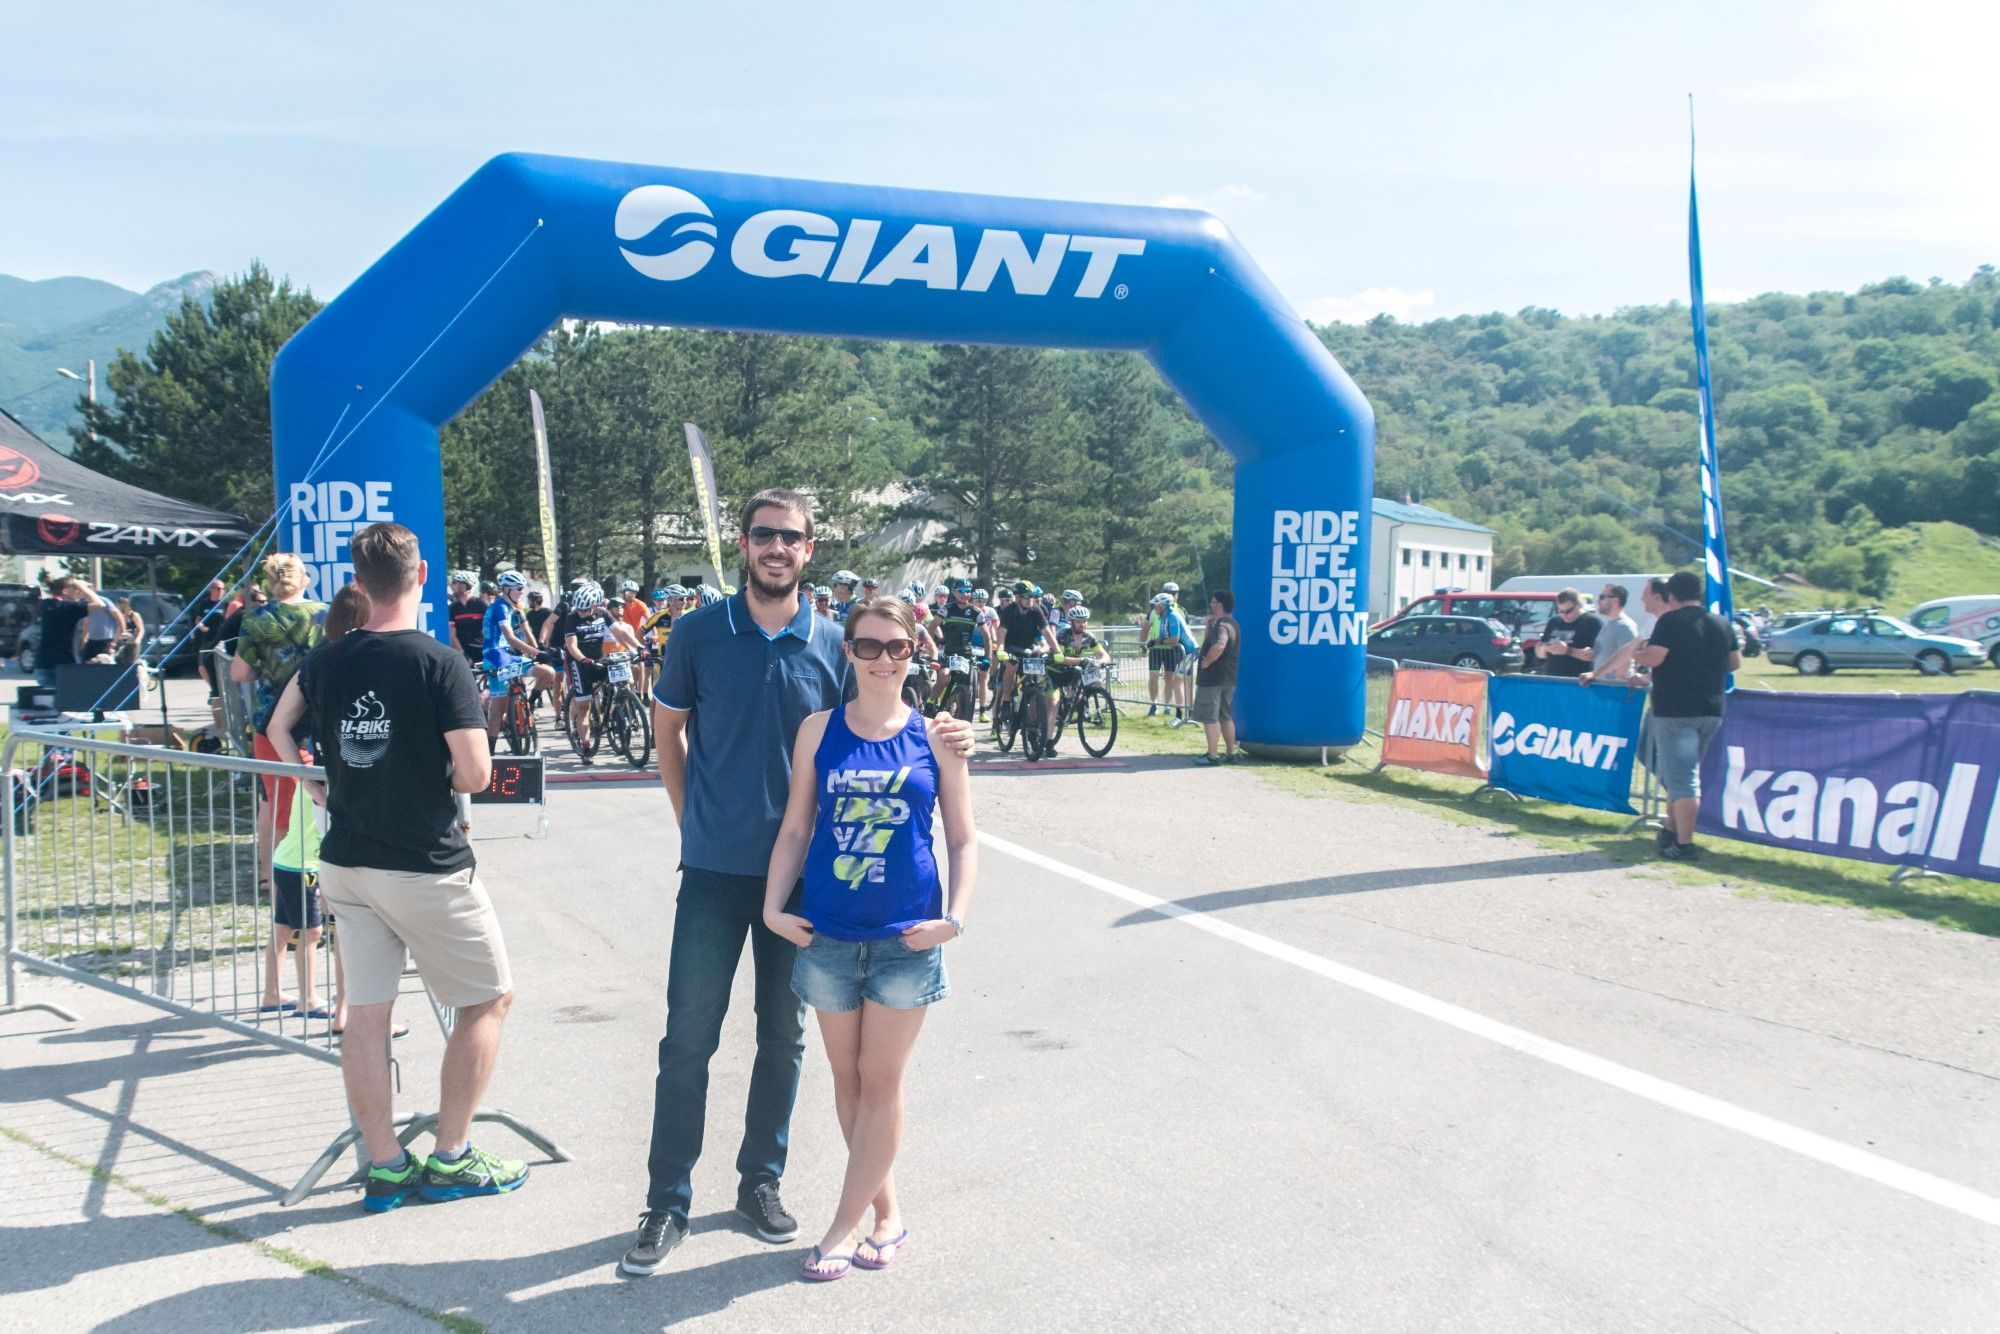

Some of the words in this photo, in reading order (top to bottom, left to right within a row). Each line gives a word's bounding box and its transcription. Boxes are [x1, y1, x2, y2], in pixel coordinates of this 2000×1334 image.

[731, 208, 1146, 299] GIANT
[289, 480, 394, 522] RIDE
[86, 521, 218, 549] 24MX
[1273, 510, 1359, 544] RIDE
[1270, 578, 1356, 612] RIDE
[1268, 611, 1369, 645] GIANT
[1515, 723, 1628, 770] GIANT
[1722, 745, 1980, 861] kanal
